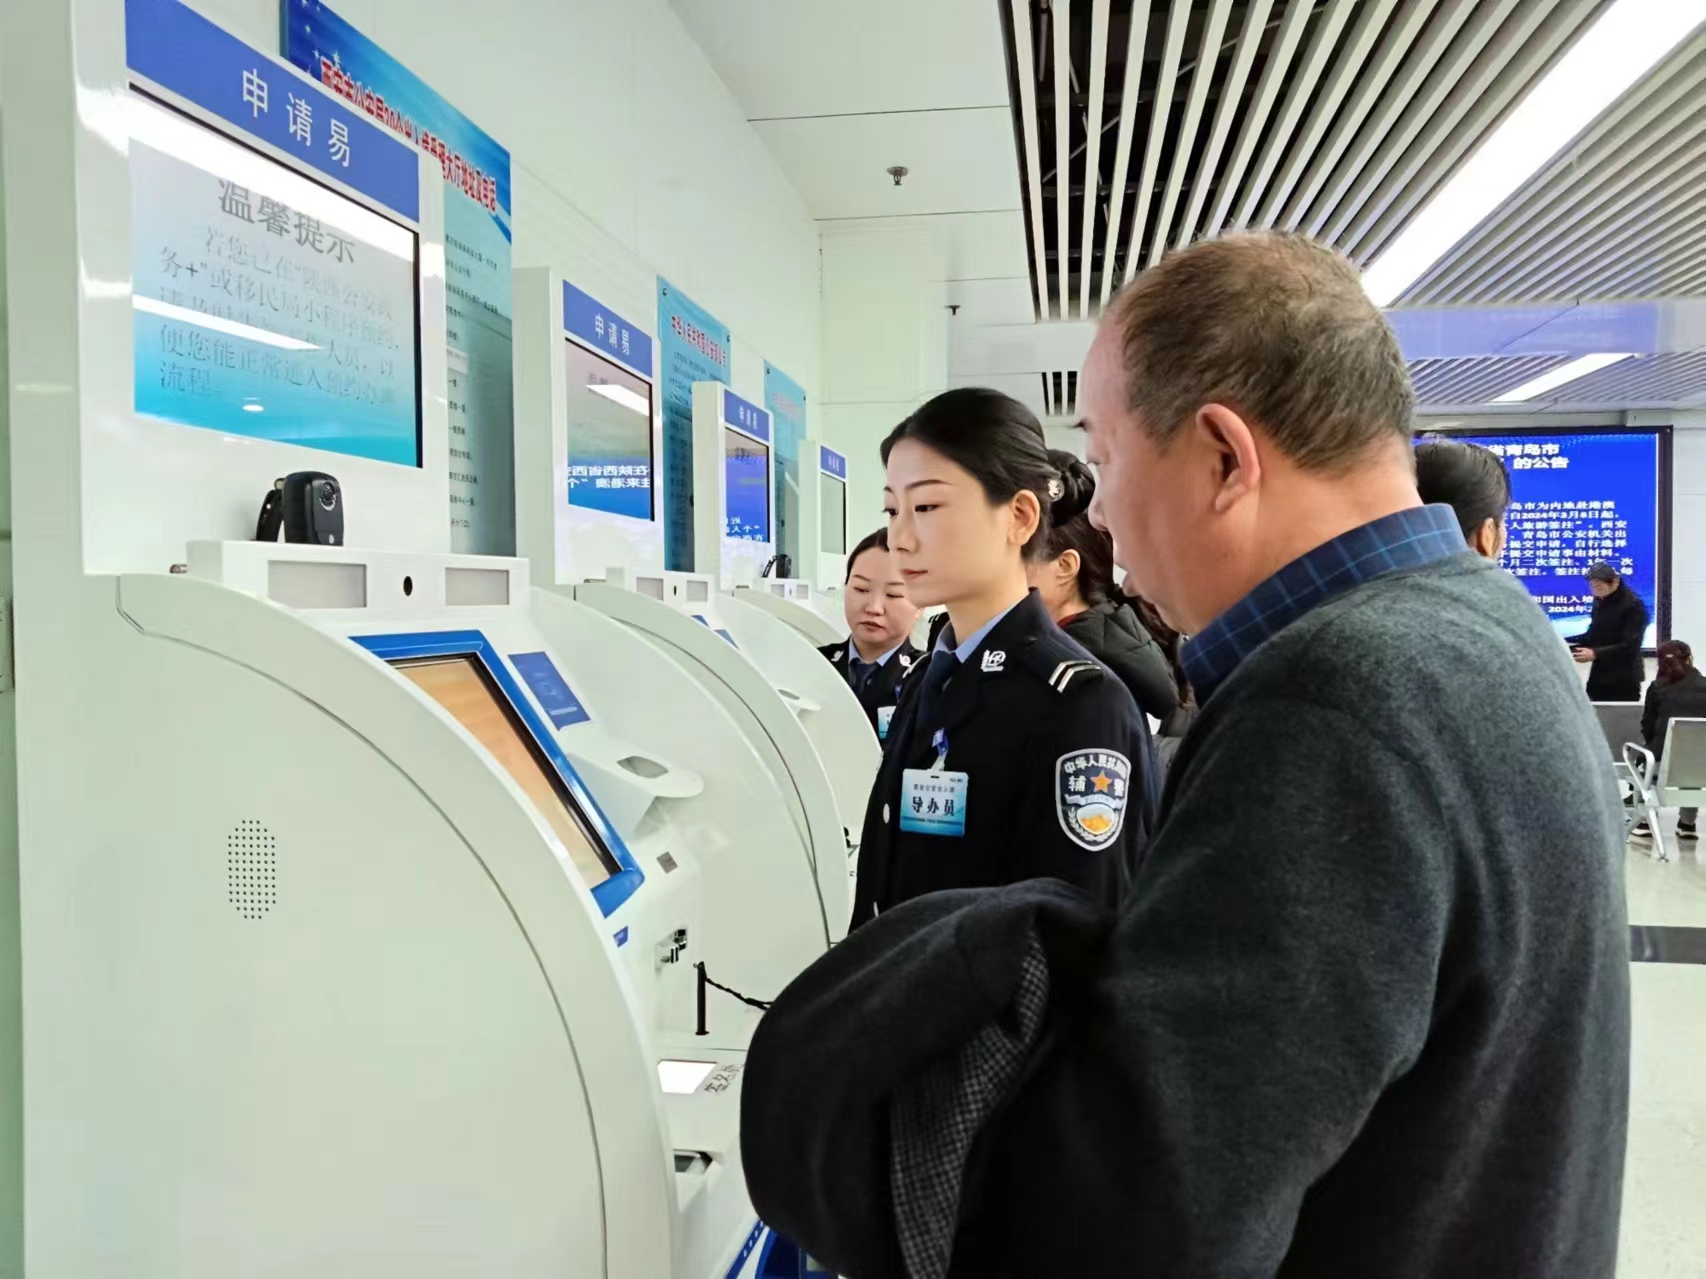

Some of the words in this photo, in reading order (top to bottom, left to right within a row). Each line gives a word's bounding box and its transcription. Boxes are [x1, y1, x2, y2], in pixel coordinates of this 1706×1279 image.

[242, 69, 351, 167] 申请易
[217, 179, 355, 264] 温馨提示
[595, 313, 630, 356] 申请易
[1068, 775, 1086, 792] 辅
[912, 796, 955, 816] 导办员
